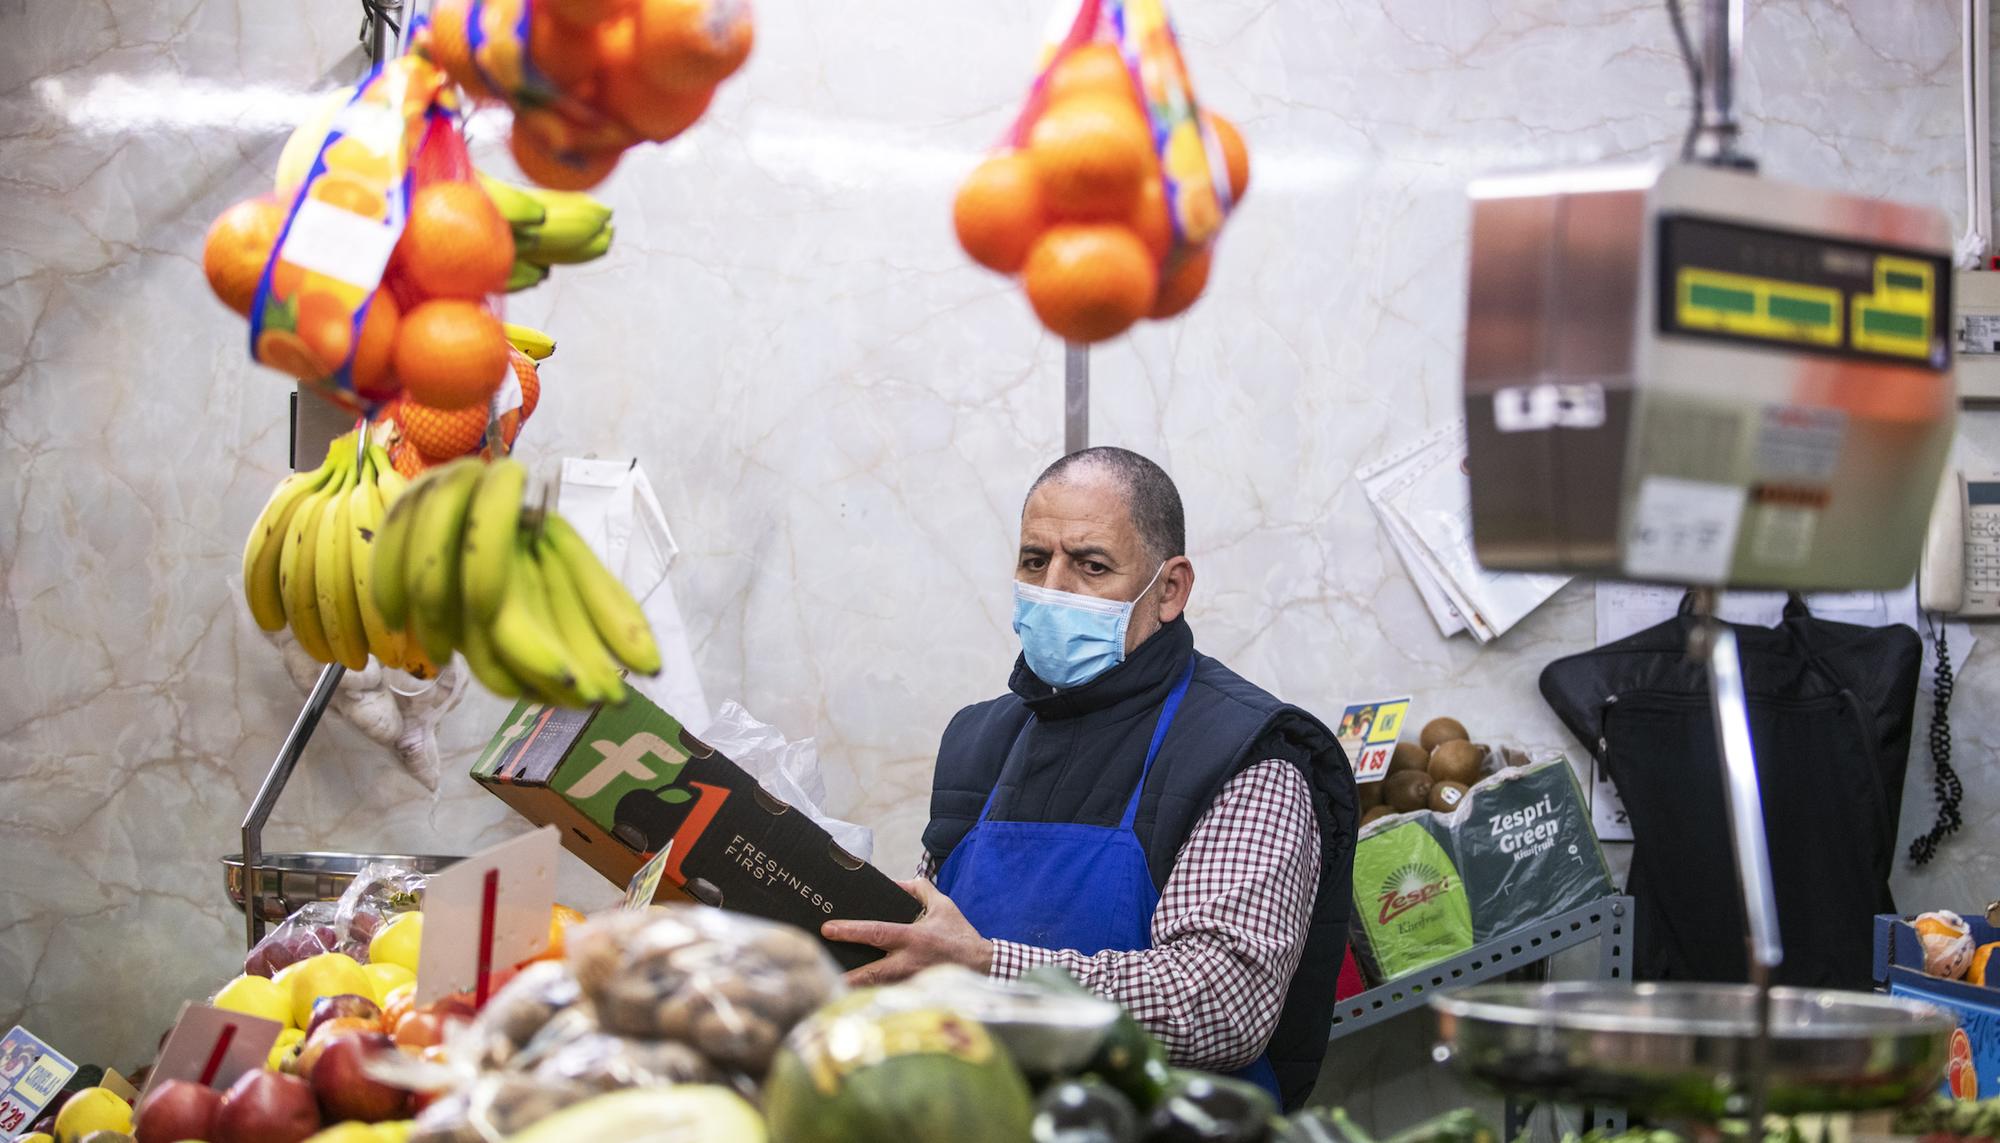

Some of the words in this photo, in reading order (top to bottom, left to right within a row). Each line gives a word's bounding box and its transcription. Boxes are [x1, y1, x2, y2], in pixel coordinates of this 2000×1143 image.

[1489, 793, 1552, 836] Zespri
[1500, 819, 1558, 854] Green
[1513, 837, 1555, 862] Kiwifruit
[725, 845, 777, 886] FIRST
[732, 834, 834, 914] FRESHNESS
